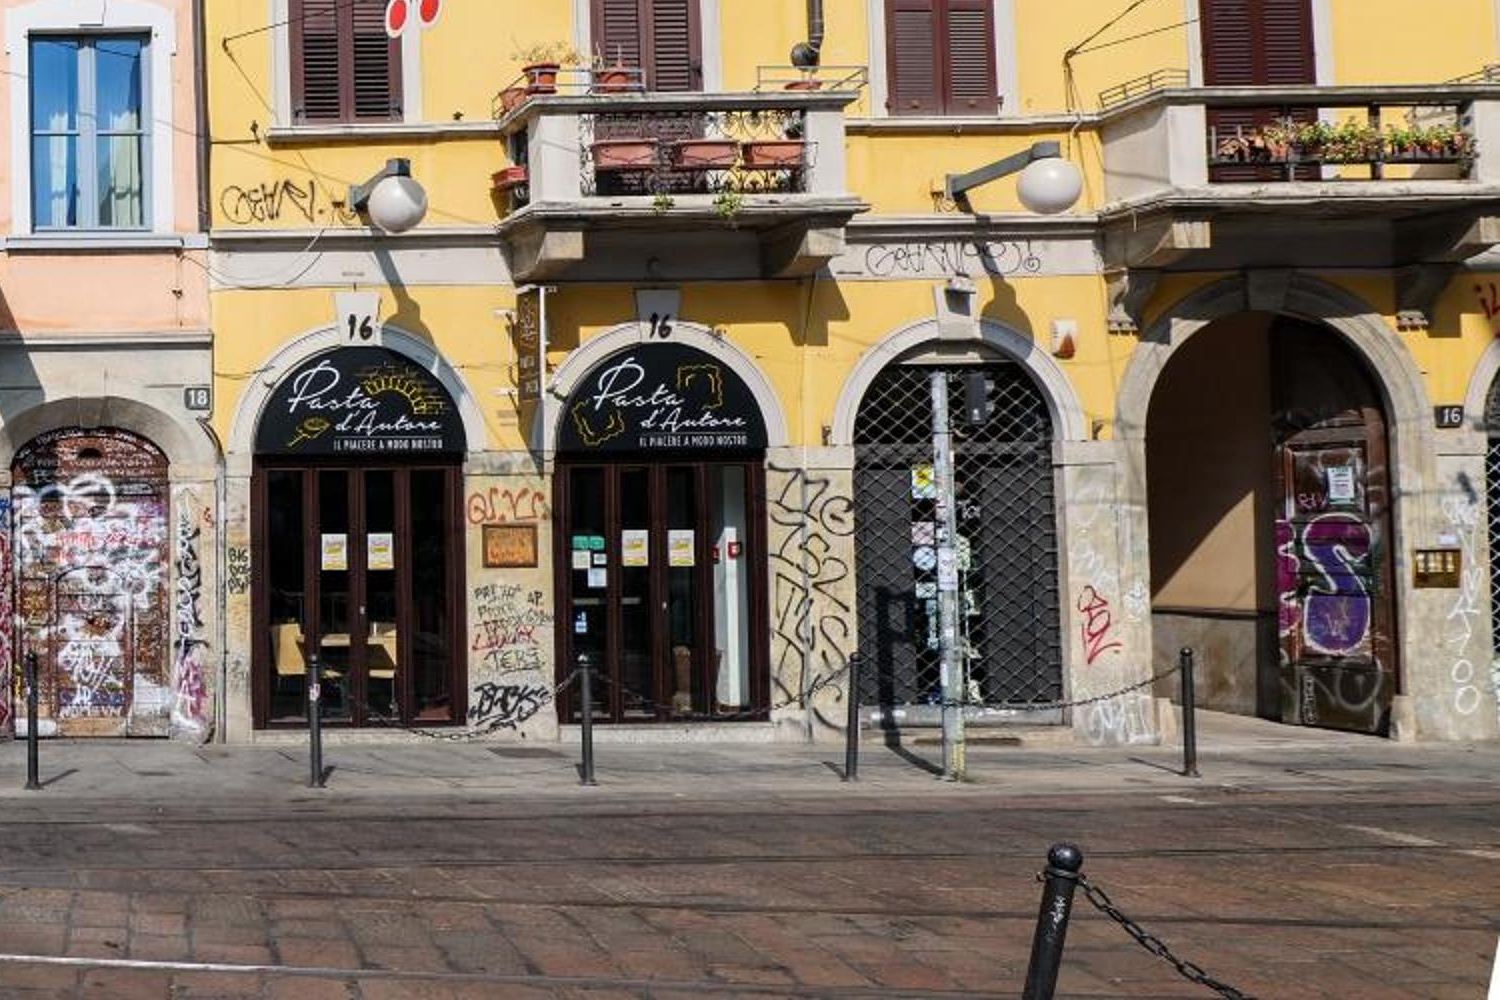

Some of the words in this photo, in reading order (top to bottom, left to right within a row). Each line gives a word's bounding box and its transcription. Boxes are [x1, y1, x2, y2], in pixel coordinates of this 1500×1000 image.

[347, 313, 374, 341] 16
[649, 312, 673, 339] 16
[287, 359, 381, 414] Pasta
[593, 356, 686, 411] Pasta
[188, 389, 208, 406] 18
[334, 410, 443, 436] d'Autore
[639, 406, 748, 432] d'Autore
[1442, 407, 1462, 424] 16
